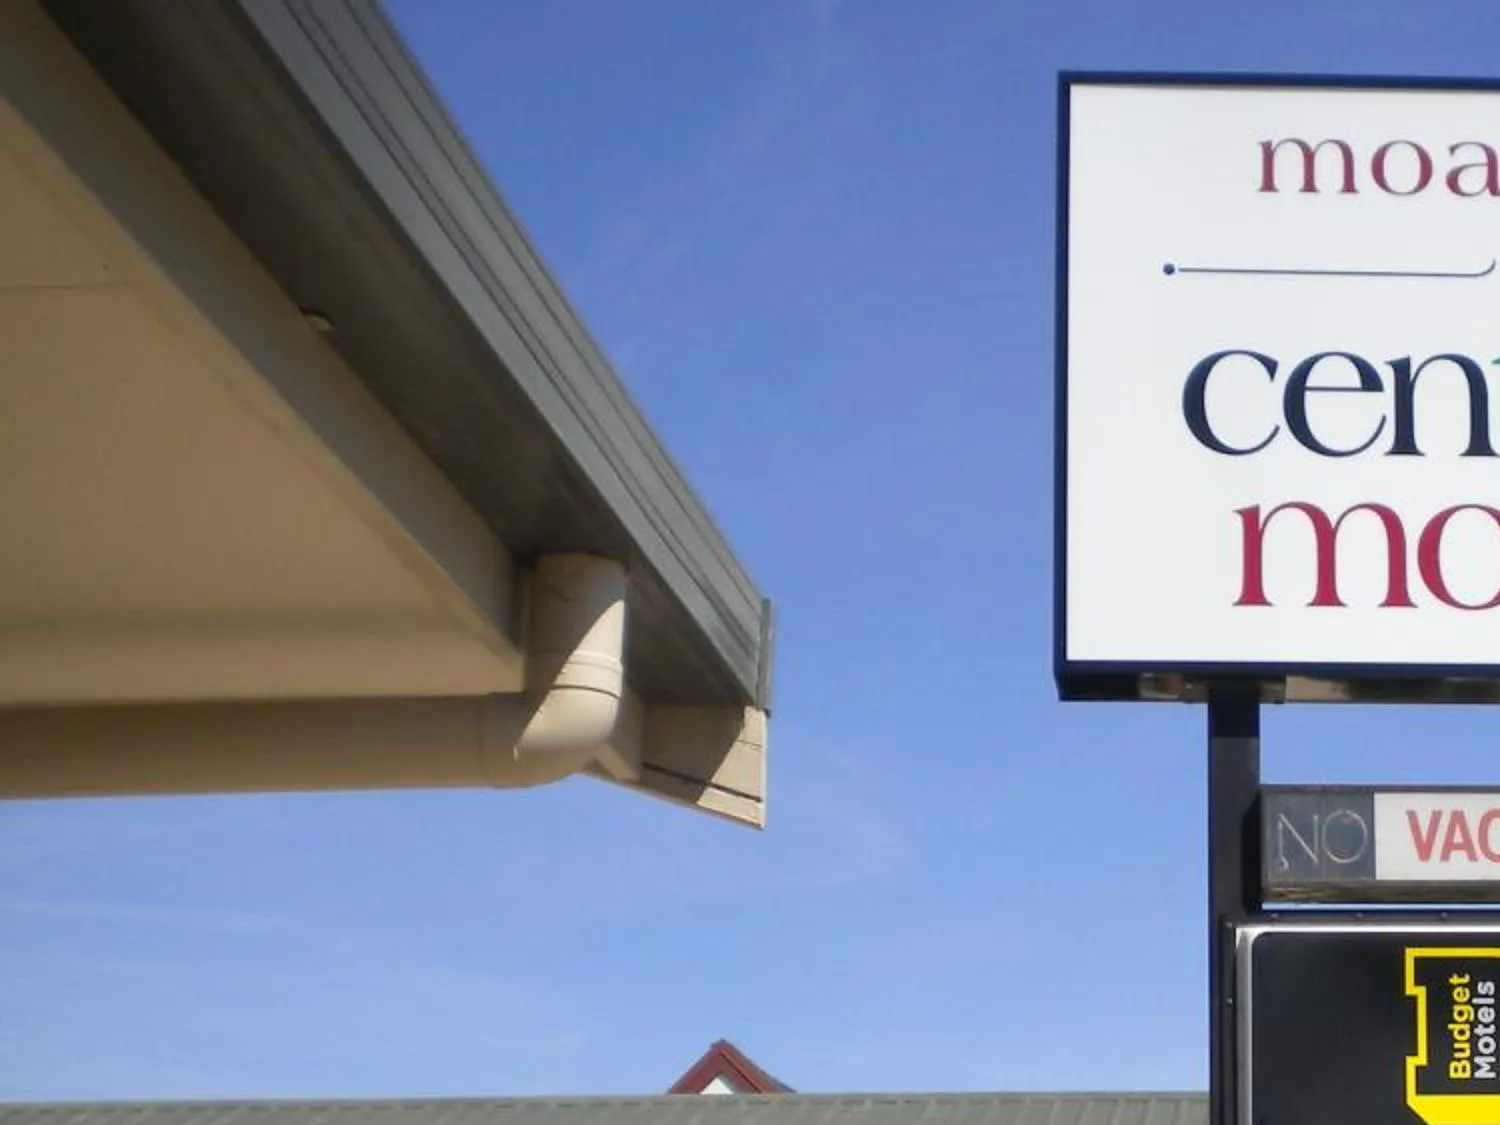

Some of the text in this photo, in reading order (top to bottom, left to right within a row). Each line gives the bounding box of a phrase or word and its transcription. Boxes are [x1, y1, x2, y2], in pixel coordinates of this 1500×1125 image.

[1276, 808, 1369, 871] NO
[1448, 972, 1475, 1079] Budget
[1472, 981, 1497, 1079] Motels
